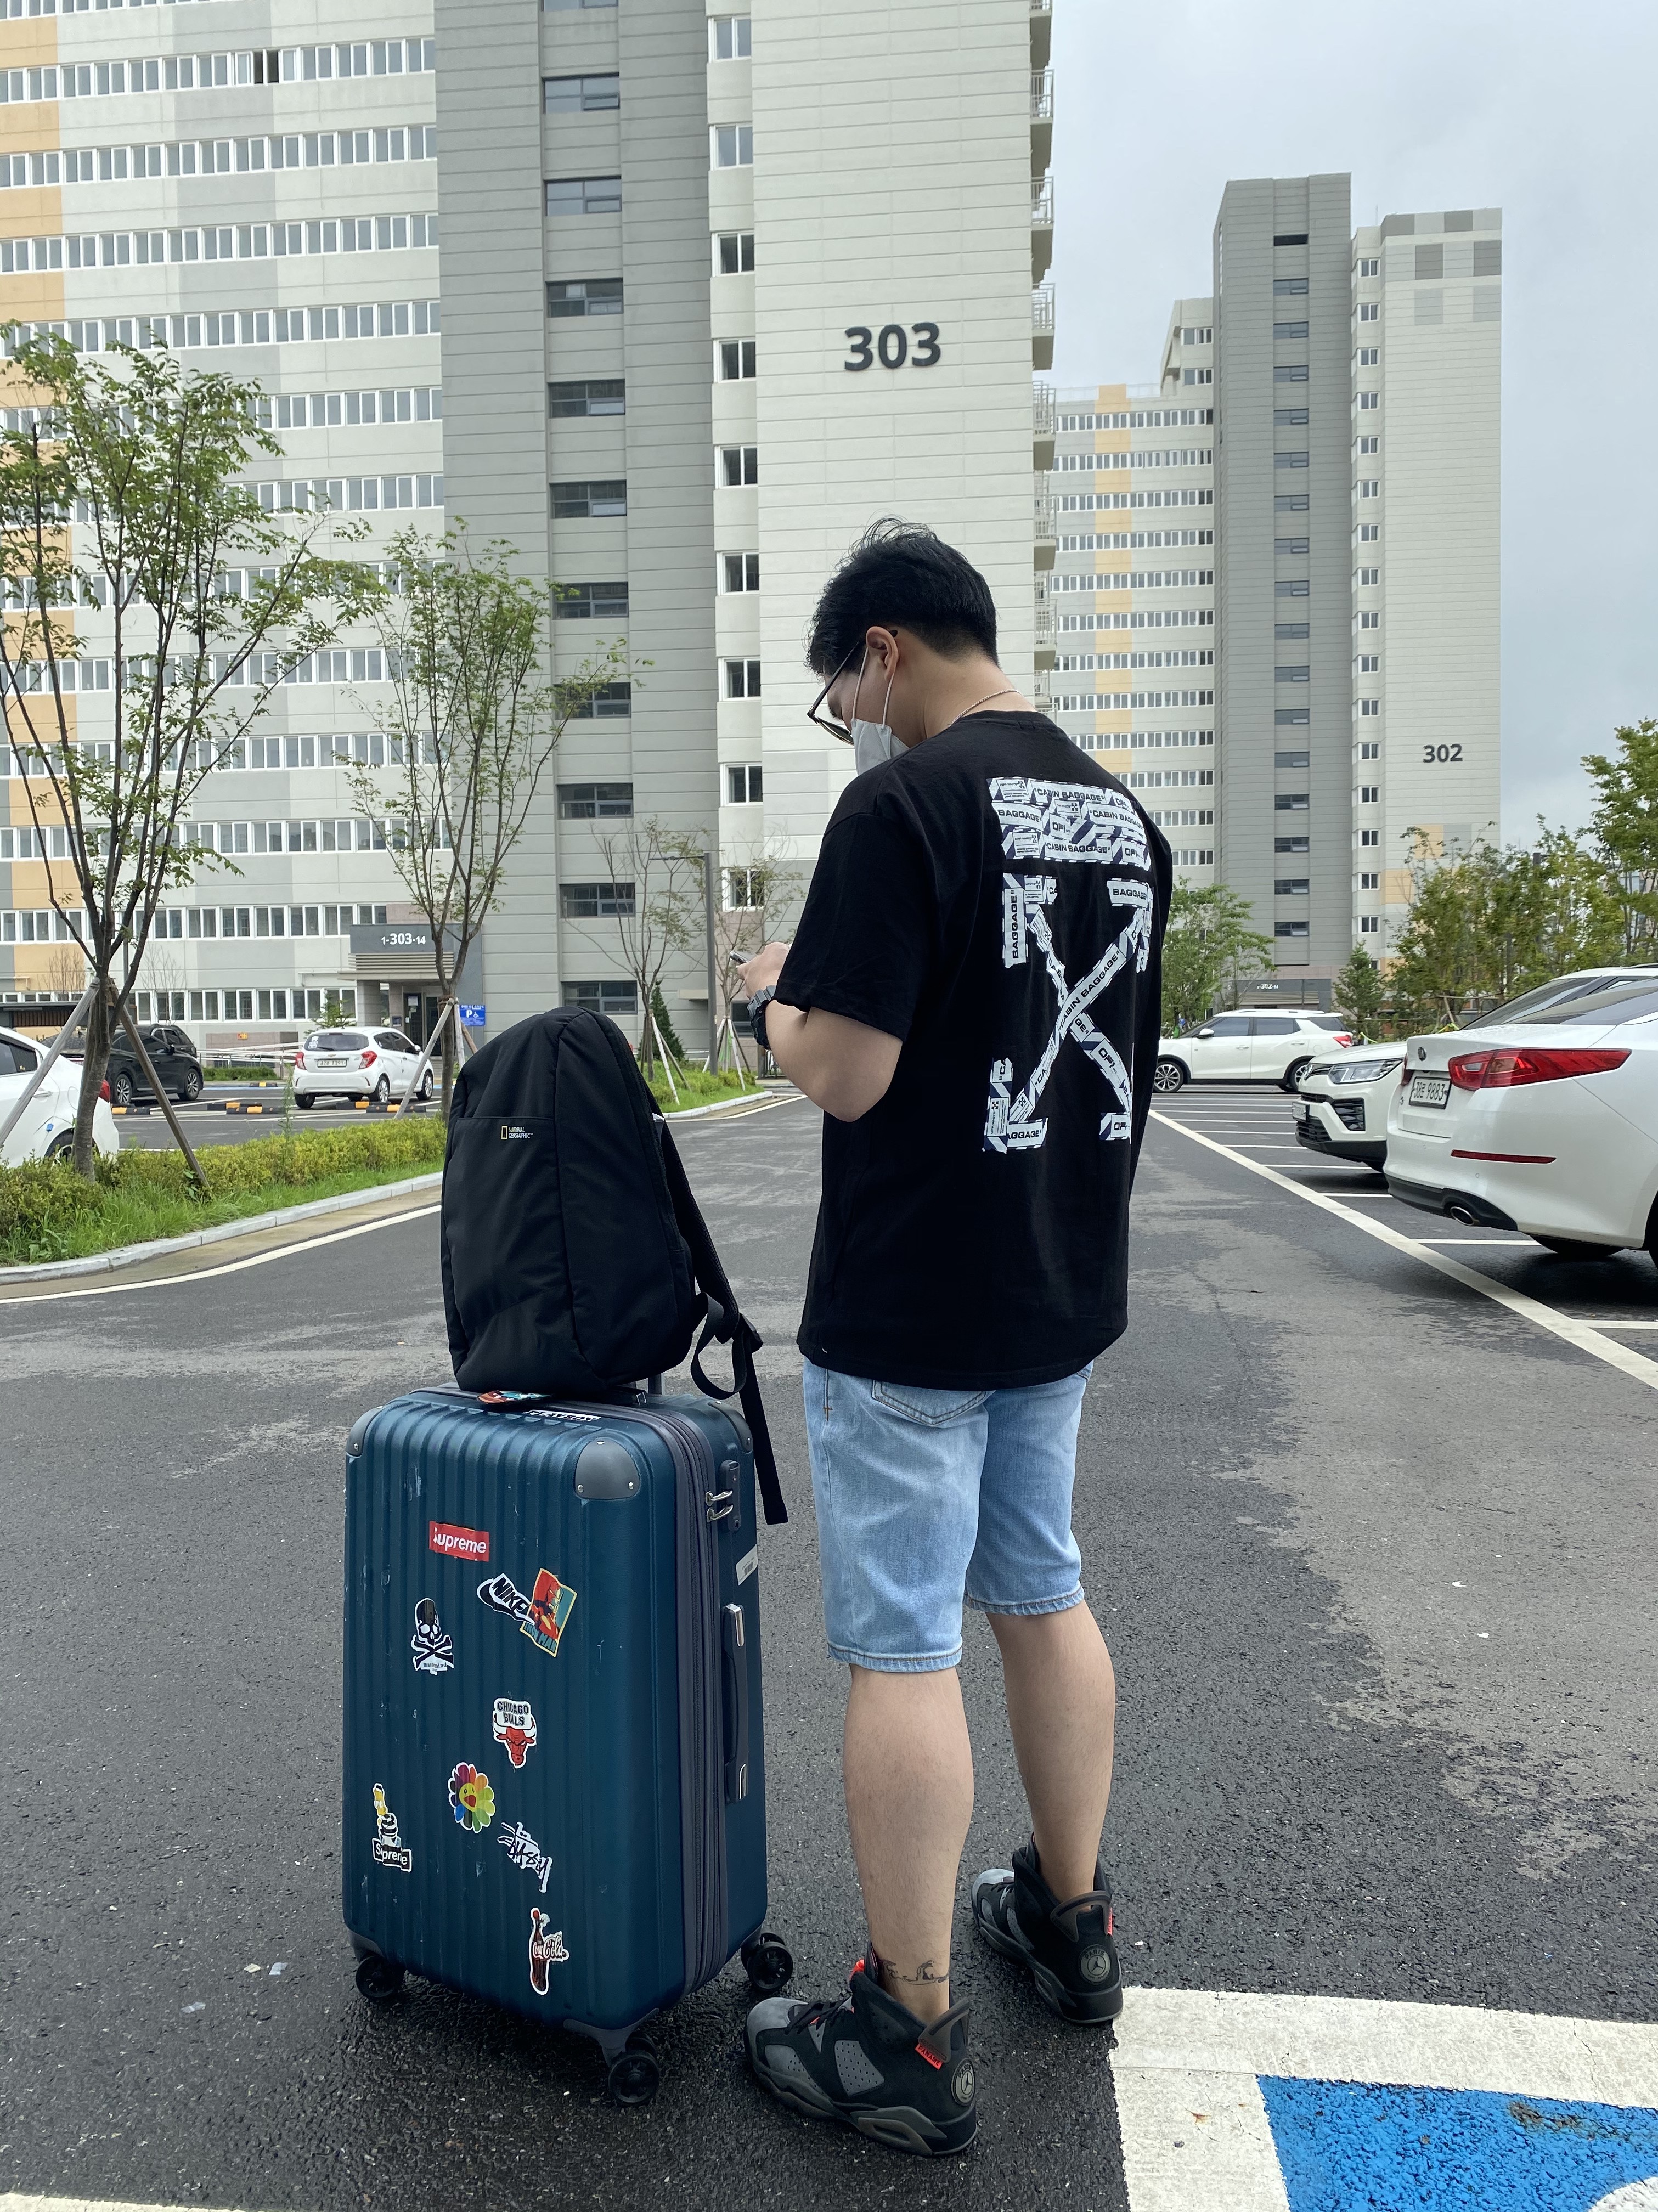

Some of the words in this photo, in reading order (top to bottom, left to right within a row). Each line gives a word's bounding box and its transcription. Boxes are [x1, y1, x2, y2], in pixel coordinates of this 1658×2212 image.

[844, 322, 941, 371] 303
[1423, 744, 1463, 763] 302
[381, 933, 426, 945] 1-303-14
[1426, 1082, 1446, 1101] 9883
[492, 1576, 531, 1614] NIKE
[497, 1701, 529, 1714] CHICAGO
[503, 1712, 525, 1726] BULLS
[1084, 1949, 1105, 1960] PARIS
[917, 2044, 941, 2067] PANAME
